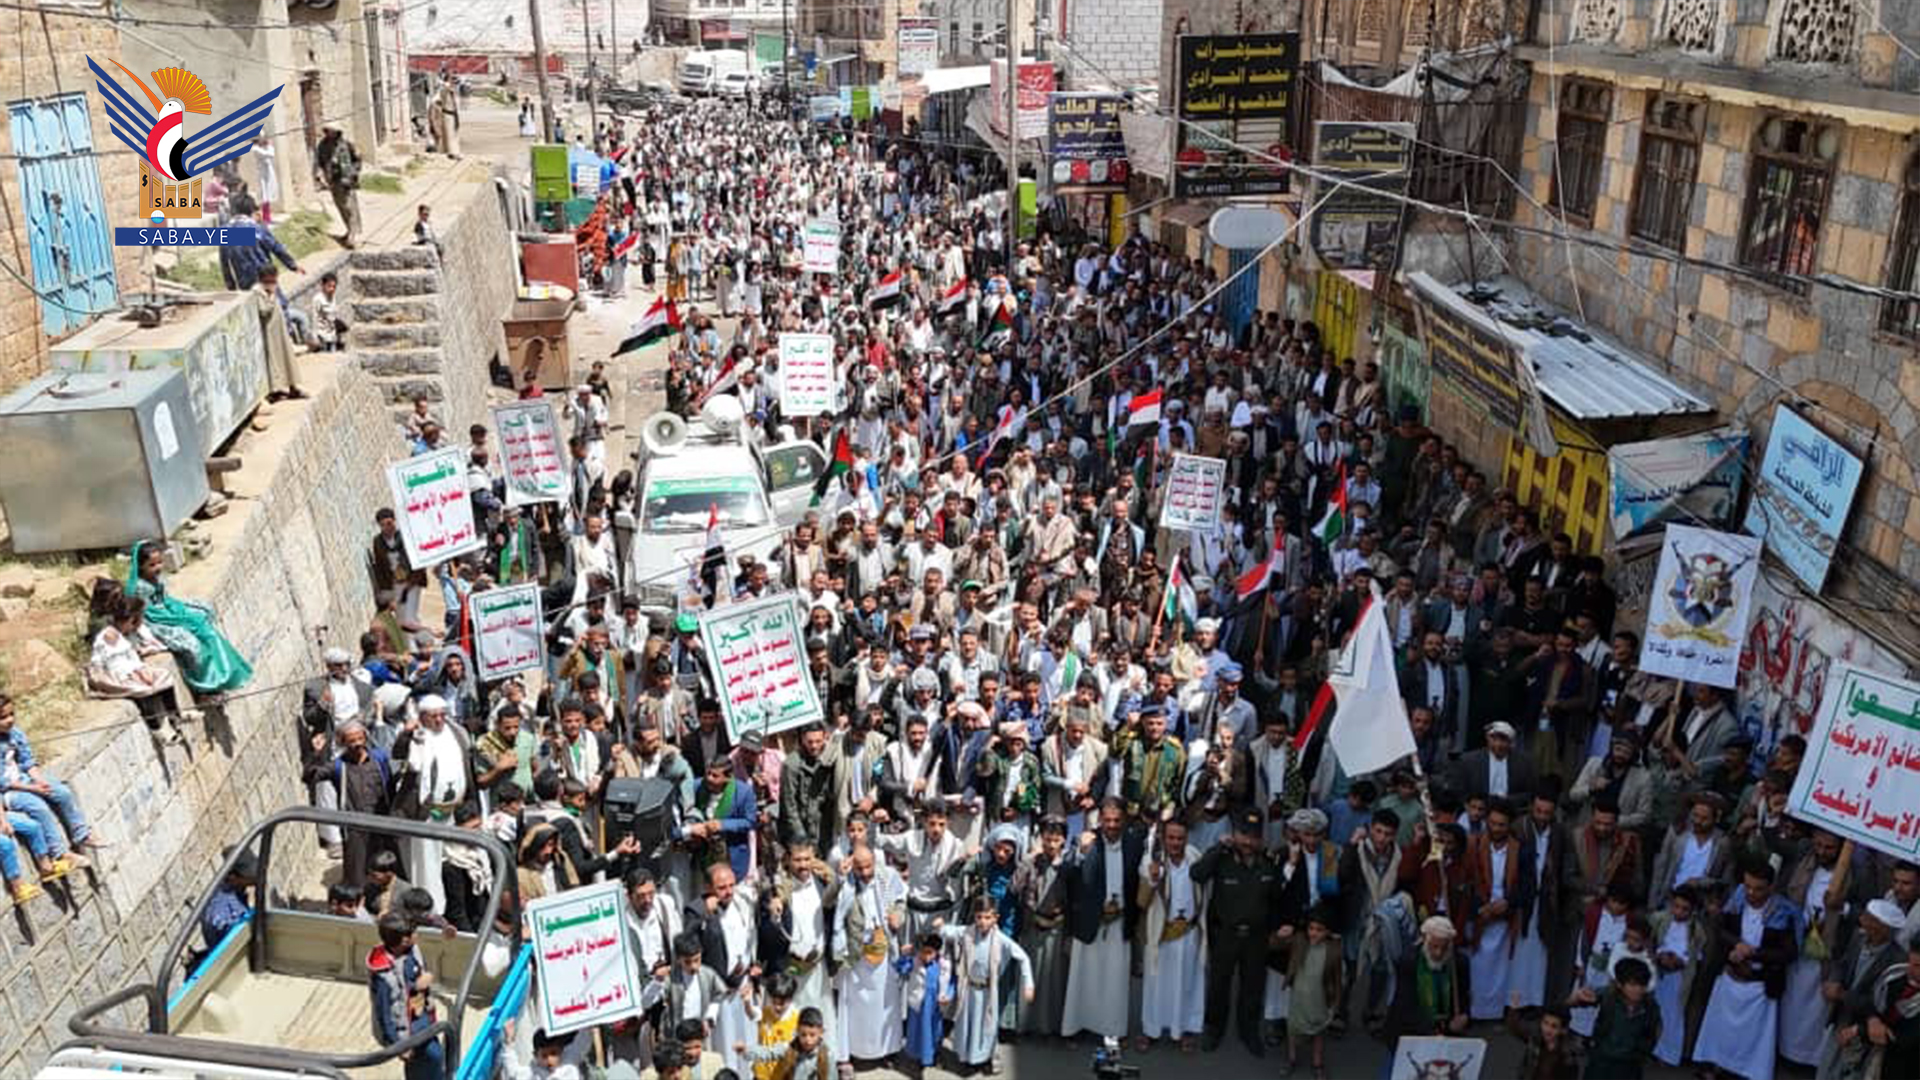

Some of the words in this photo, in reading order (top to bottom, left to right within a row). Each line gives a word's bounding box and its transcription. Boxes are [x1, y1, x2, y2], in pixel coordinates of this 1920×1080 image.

[1249, 68, 1289, 84] محمد
[1055, 97, 1097, 115] الملك
[1228, 95, 1236, 114] و
[1238, 90, 1287, 111] للذهب
[719, 614, 759, 648] أكبر
[762, 609, 790, 631] الله
[1845, 678, 1920, 731] طعوا
[1865, 765, 1879, 790] و
[539, 901, 616, 937] قاطعوا
